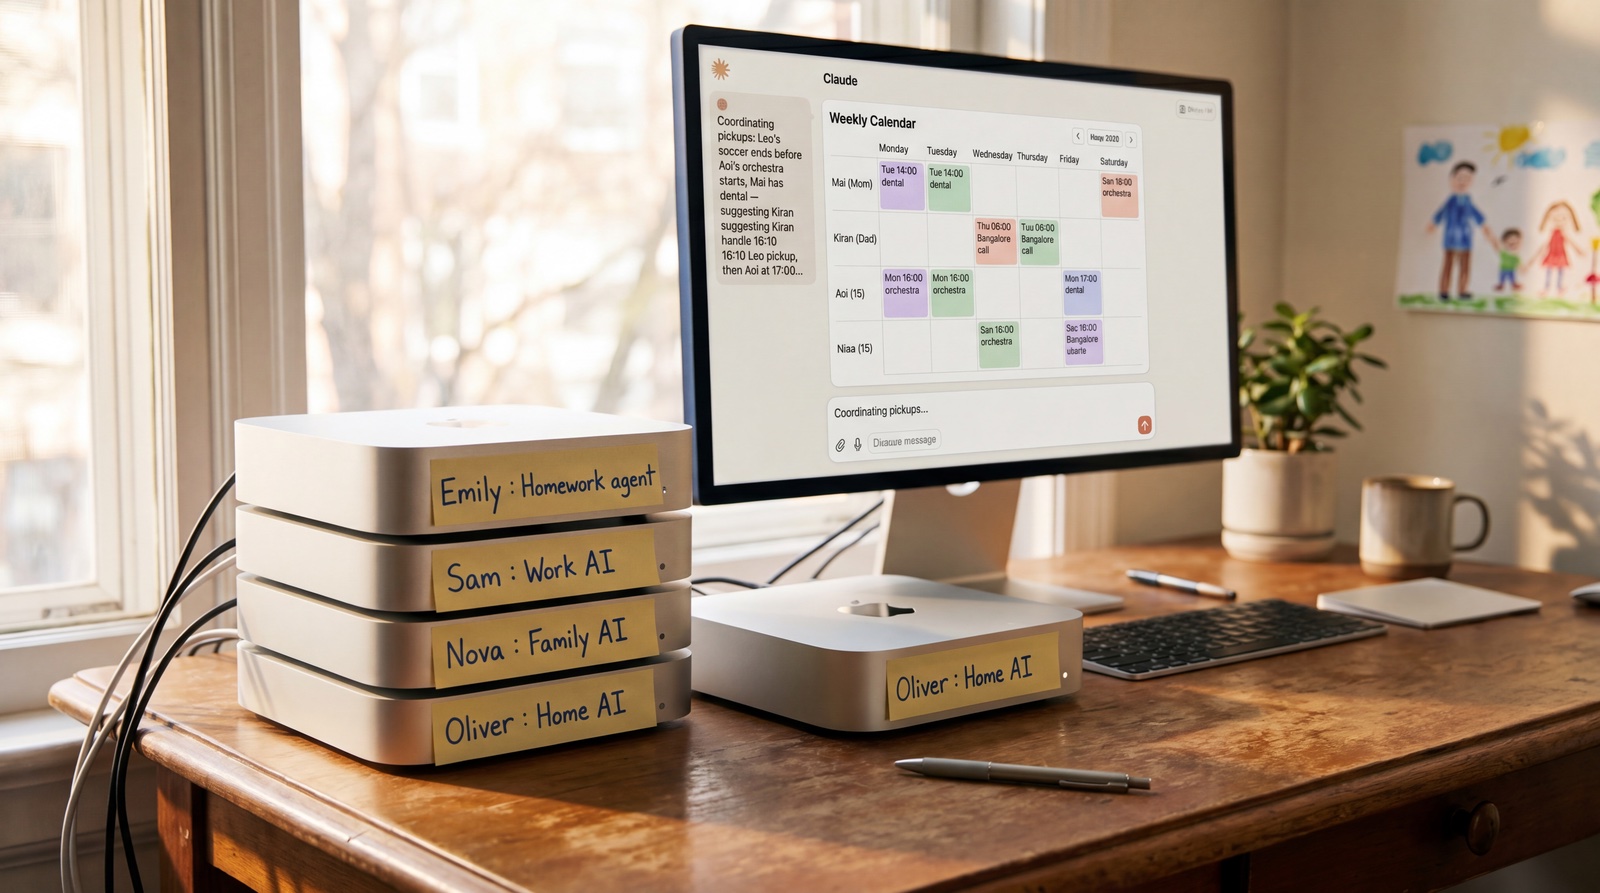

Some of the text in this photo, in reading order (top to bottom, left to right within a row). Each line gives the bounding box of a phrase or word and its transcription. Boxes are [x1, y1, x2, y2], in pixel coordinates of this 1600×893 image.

[823, 72, 858, 86] Claude
[717, 115, 774, 131] Coordinating
[829, 111, 916, 129] Weekly Calendar
[718, 130, 781, 144] pickups: Leo's
[718, 147, 802, 160] soccer ends before
[878, 143, 909, 155] Monday
[926, 146, 957, 158] Tuesday
[972, 149, 1013, 161] Wednesday
[1017, 151, 1048, 163] Thursday
[1059, 155, 1080, 165] Friday
[719, 160, 784, 173] Aoi's orchestra
[1100, 158, 1128, 168] Saturday
[881, 164, 917, 175] Tue 14:00
[929, 168, 963, 178] Tue 14:00
[719, 176, 784, 188] starts, Mai has
[831, 177, 873, 190] Mai (Mom)
[881, 177, 904, 187] dental
[930, 180, 951, 189] dental
[720, 191, 748, 201] dental
[1102, 189, 1131, 198] orchestra
[720, 206, 794, 219] suggesting Kiran
[721, 221, 794, 233] suggesting Kiran
[977, 221, 1011, 231] Thu 06:00
[1035, 223, 1055, 232] 06:00
[721, 235, 777, 246] handle 16:10
[833, 233, 877, 245] Kiran (Dad)
[977, 234, 1011, 244] Bangalore
[1021, 235, 1054, 245] Bangalore
[977, 245, 989, 254] call
[1021, 247, 1033, 255] call
[721, 250, 798, 263] 16:10 Leo pickup,
[722, 265, 742, 275] then
[744, 265, 759, 275] Aoi
[761, 266, 770, 275] at
[884, 273, 923, 282] Mon 16:00
[932, 273, 969, 282] Mon 16:00
[1065, 274, 1097, 283] Mon 17:00
[835, 288, 865, 300] Aoi (15)
[885, 286, 920, 295] orchestra
[933, 286, 966, 295] orchestra
[1065, 286, 1084, 294] dental
[980, 337, 1013, 346] orchestra
[1066, 335, 1098, 346] Bangalore
[858, 343, 873, 355] (15)
[834, 406, 888, 419] Coordinating
[904, 436, 937, 446] message
[441, 463, 656, 515] Emily : Homework agent
[447, 548, 616, 593] Sam : Work AI
[446, 617, 628, 669] Nova : Family AI
[896, 654, 1033, 702] Oliver : Home AI
[445, 689, 627, 745] Oliver : Home AI
